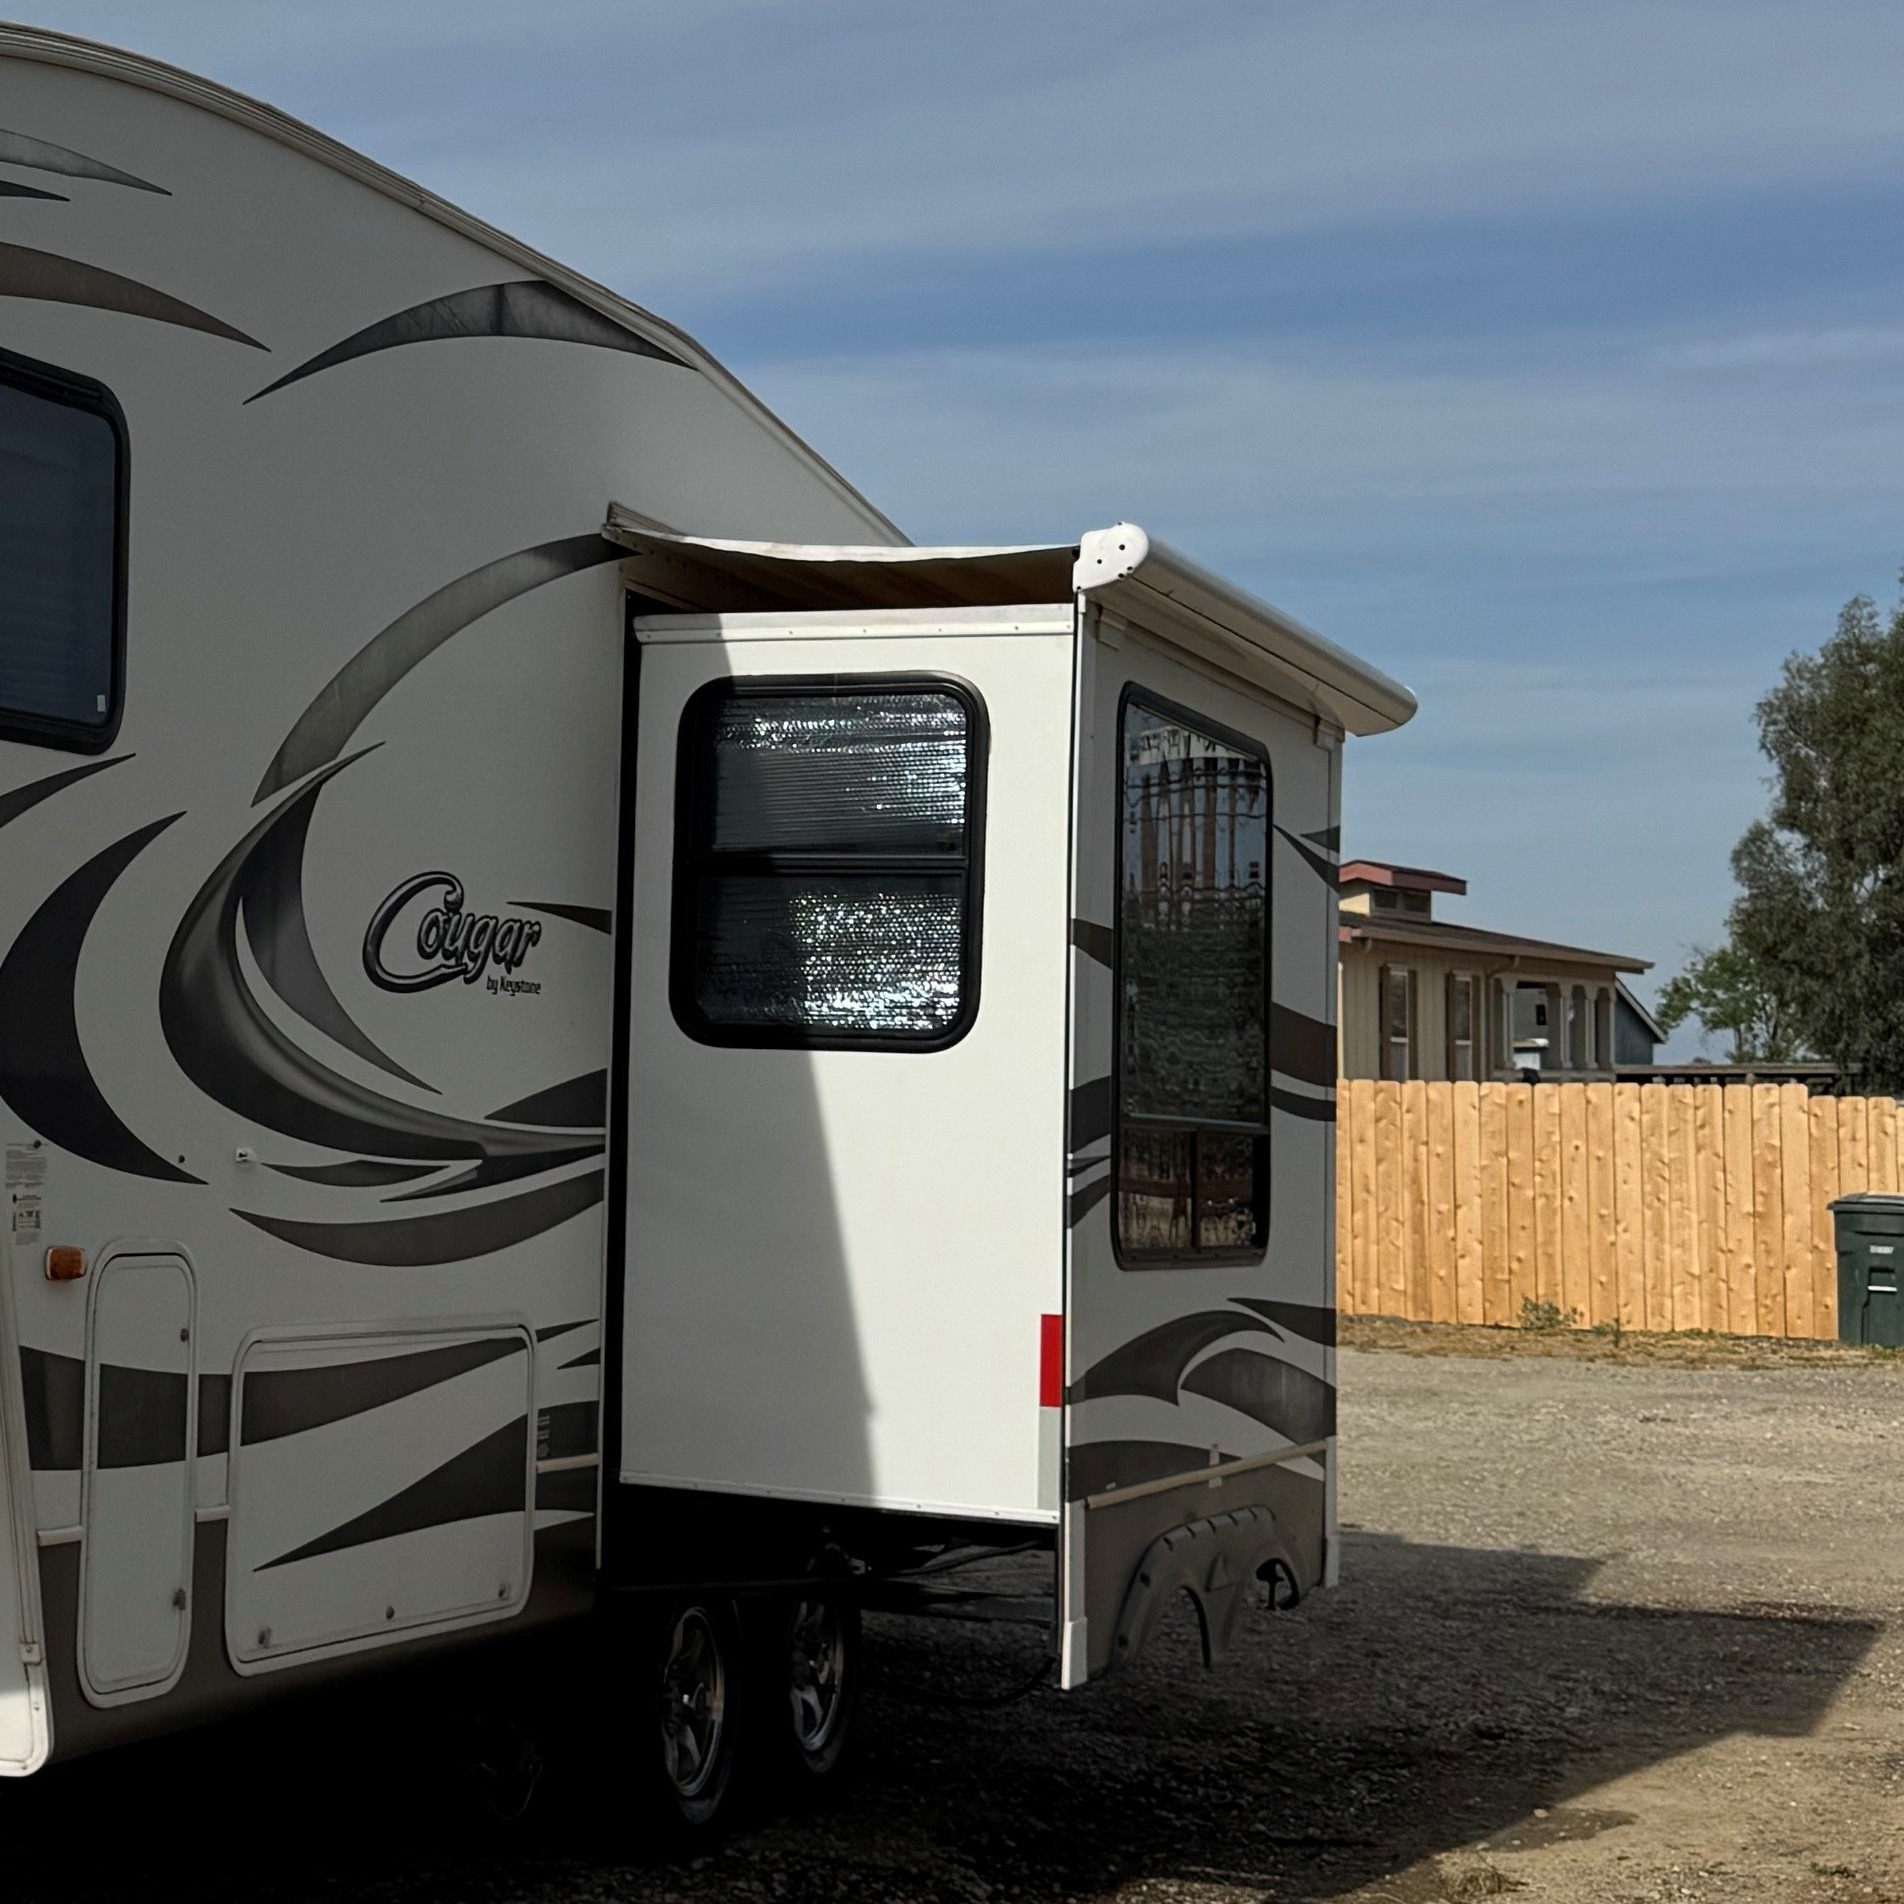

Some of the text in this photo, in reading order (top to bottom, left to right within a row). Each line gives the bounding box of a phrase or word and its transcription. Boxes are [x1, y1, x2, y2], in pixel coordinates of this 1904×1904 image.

[362, 871, 542, 994] Cougar
[486, 976, 541, 996] by Keystone
